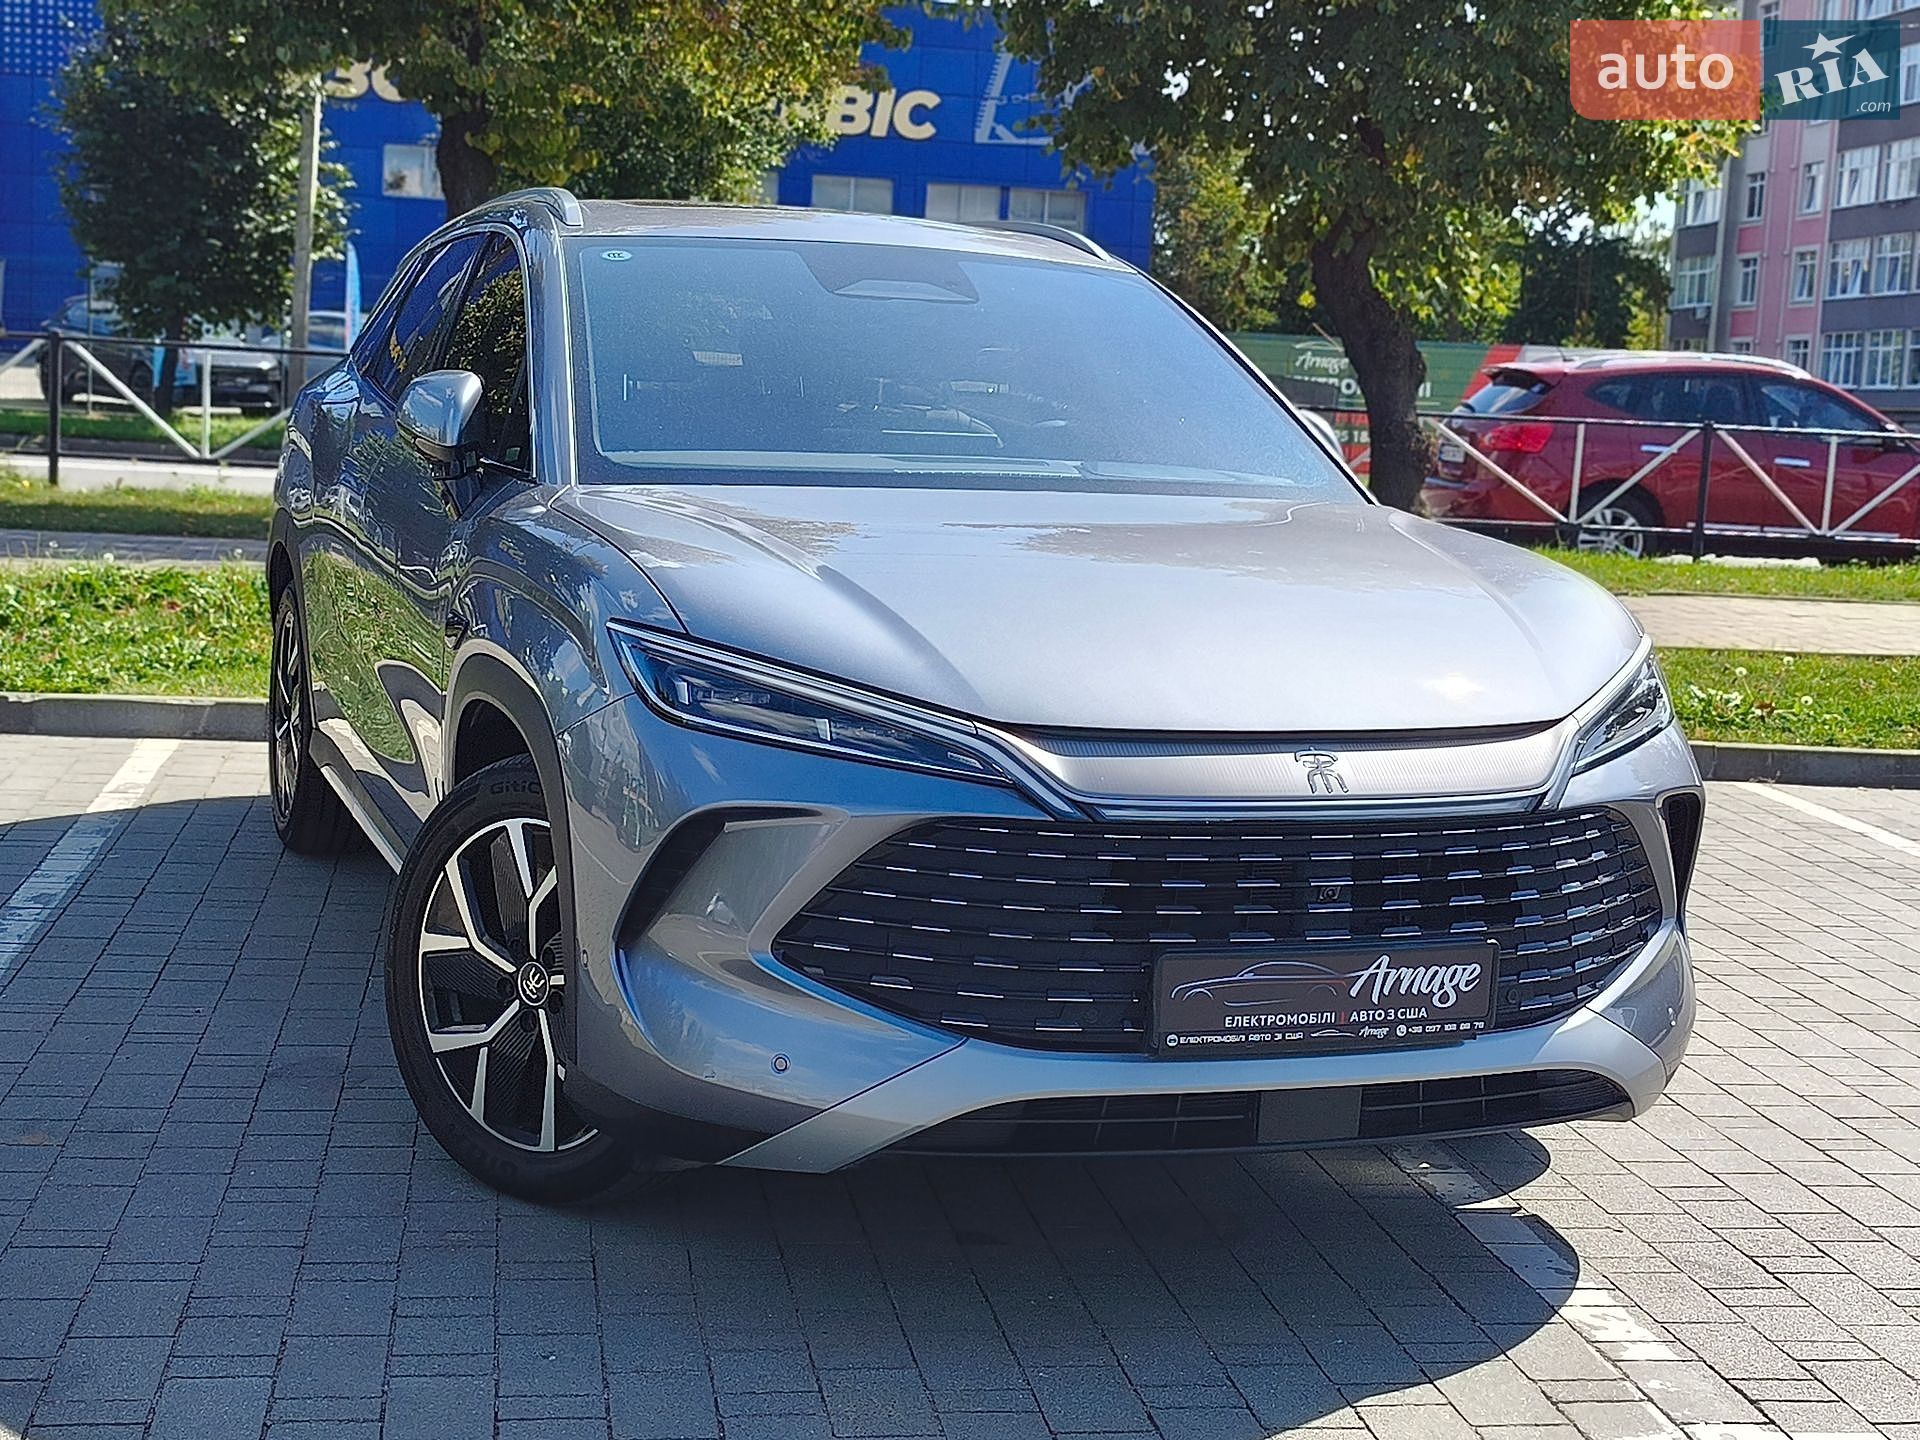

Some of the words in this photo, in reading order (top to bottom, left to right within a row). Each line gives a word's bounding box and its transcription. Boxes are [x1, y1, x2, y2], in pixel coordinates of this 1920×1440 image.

[1349, 955, 1481, 1008] Arnage
[1224, 1011, 1336, 1028] ЕЛЕКТРОМОБІЛІ
[1349, 1009, 1385, 1022] АВТО
[1397, 1007, 1428, 1019] США
[1359, 1025, 1389, 1038] Arnage
